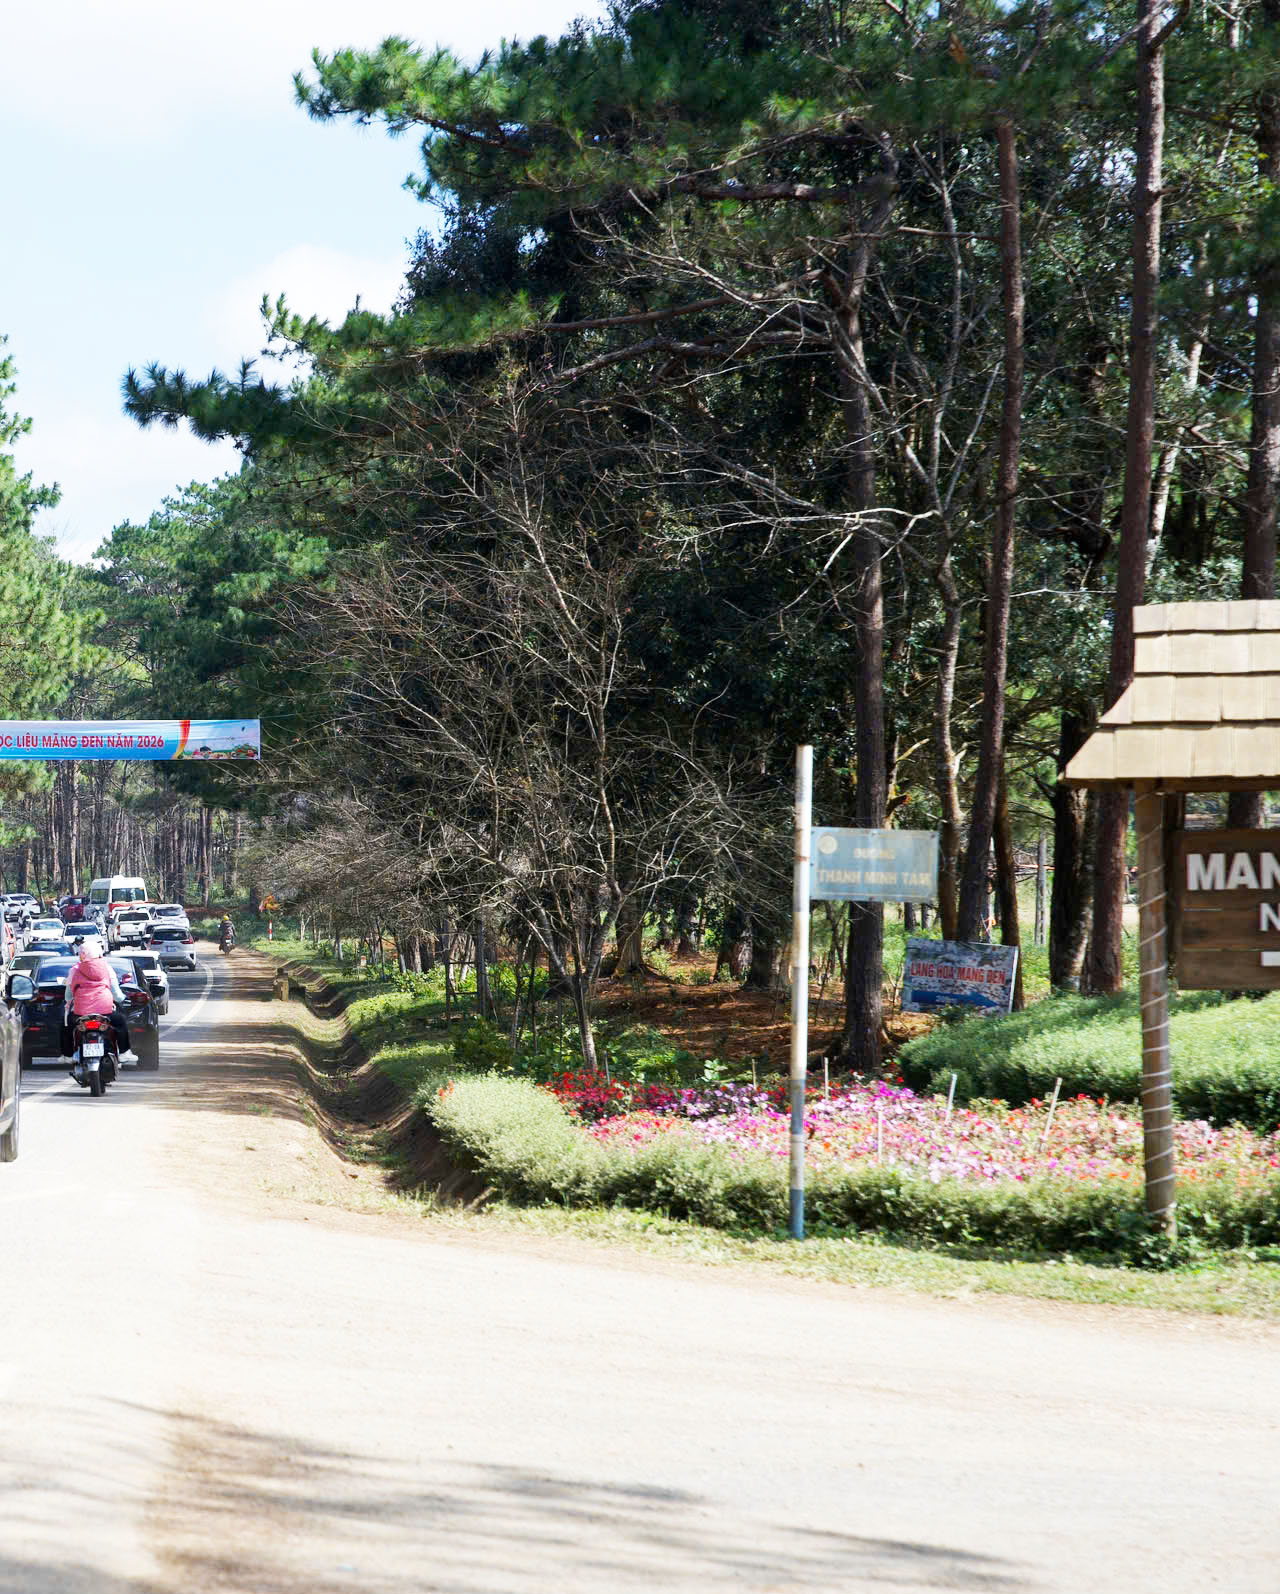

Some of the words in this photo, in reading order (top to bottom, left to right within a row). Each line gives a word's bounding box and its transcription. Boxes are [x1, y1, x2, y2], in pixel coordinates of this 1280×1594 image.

[16, 732, 38, 751] LIỆU
[81, 735, 104, 748] ĐEN
[107, 733, 133, 748] NĂM
[137, 735, 165, 748] 2026
